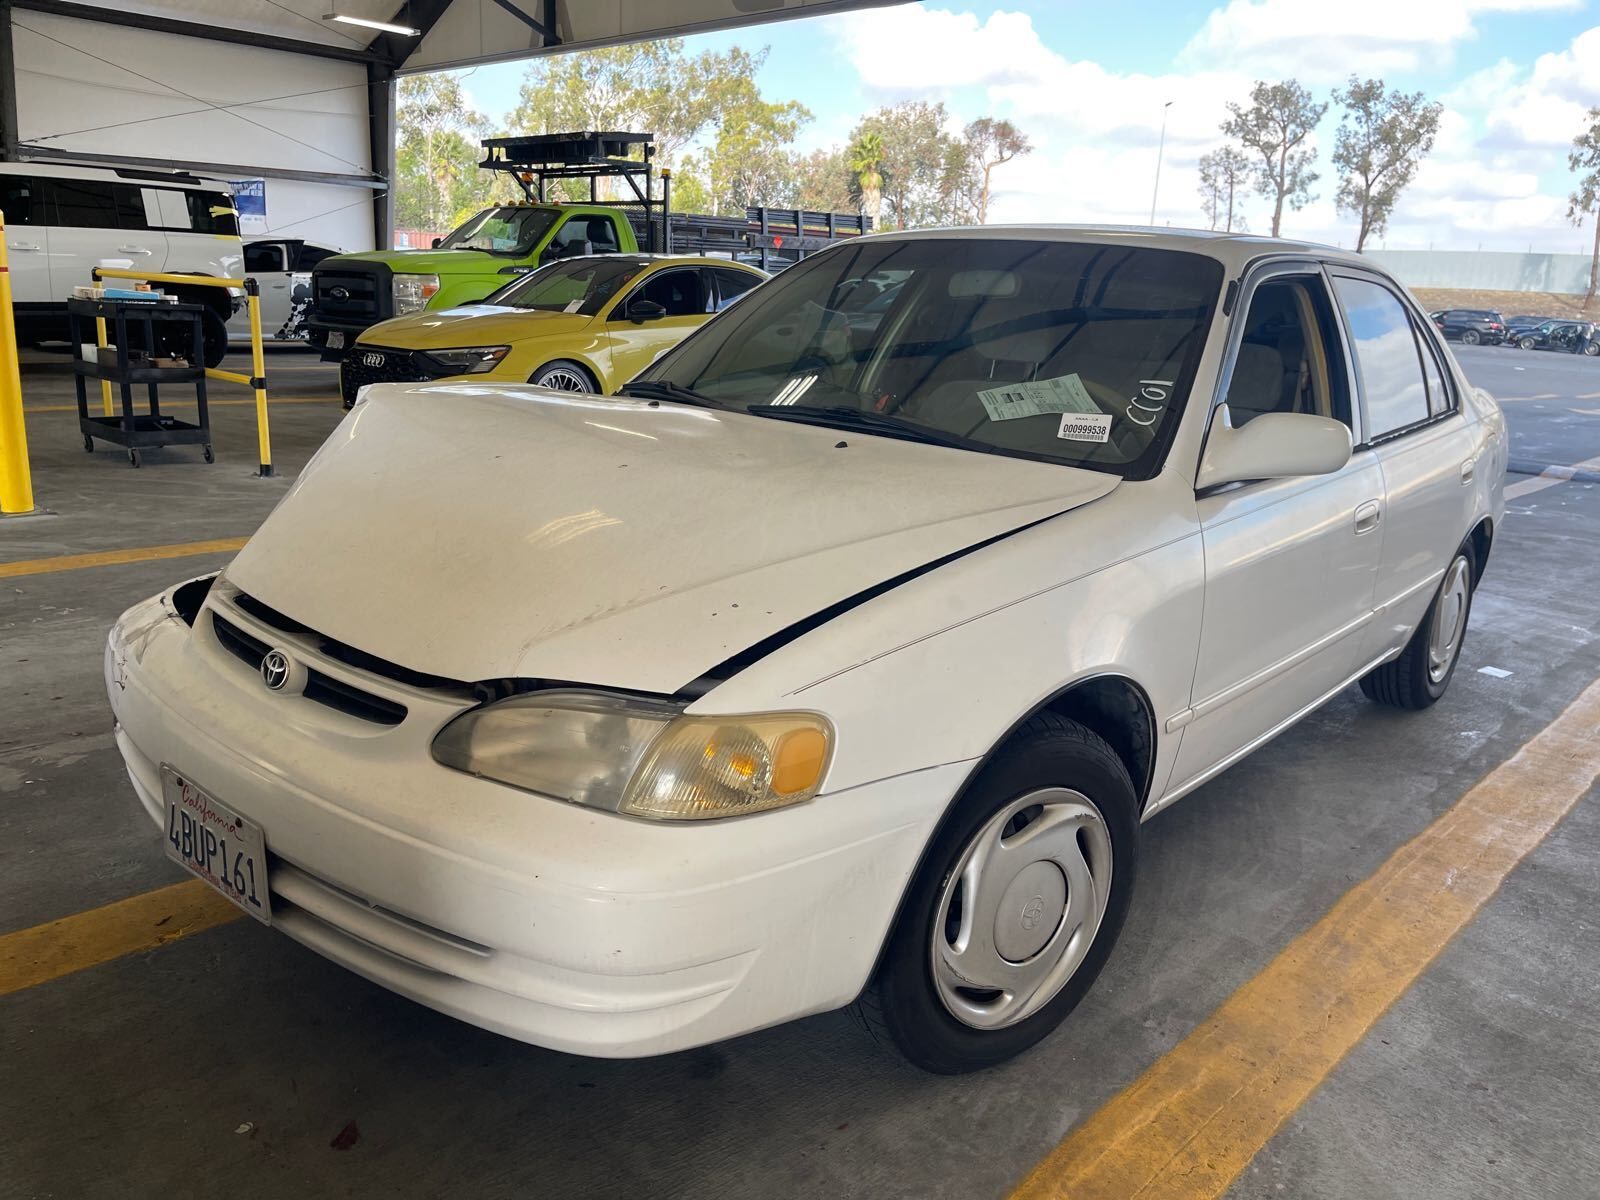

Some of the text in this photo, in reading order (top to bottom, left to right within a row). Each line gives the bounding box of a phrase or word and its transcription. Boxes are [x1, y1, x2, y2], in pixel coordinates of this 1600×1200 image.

[1063, 423, 1107, 436] 000999538
[182, 784, 244, 842] California
[169, 801, 262, 908] 4BUP161
